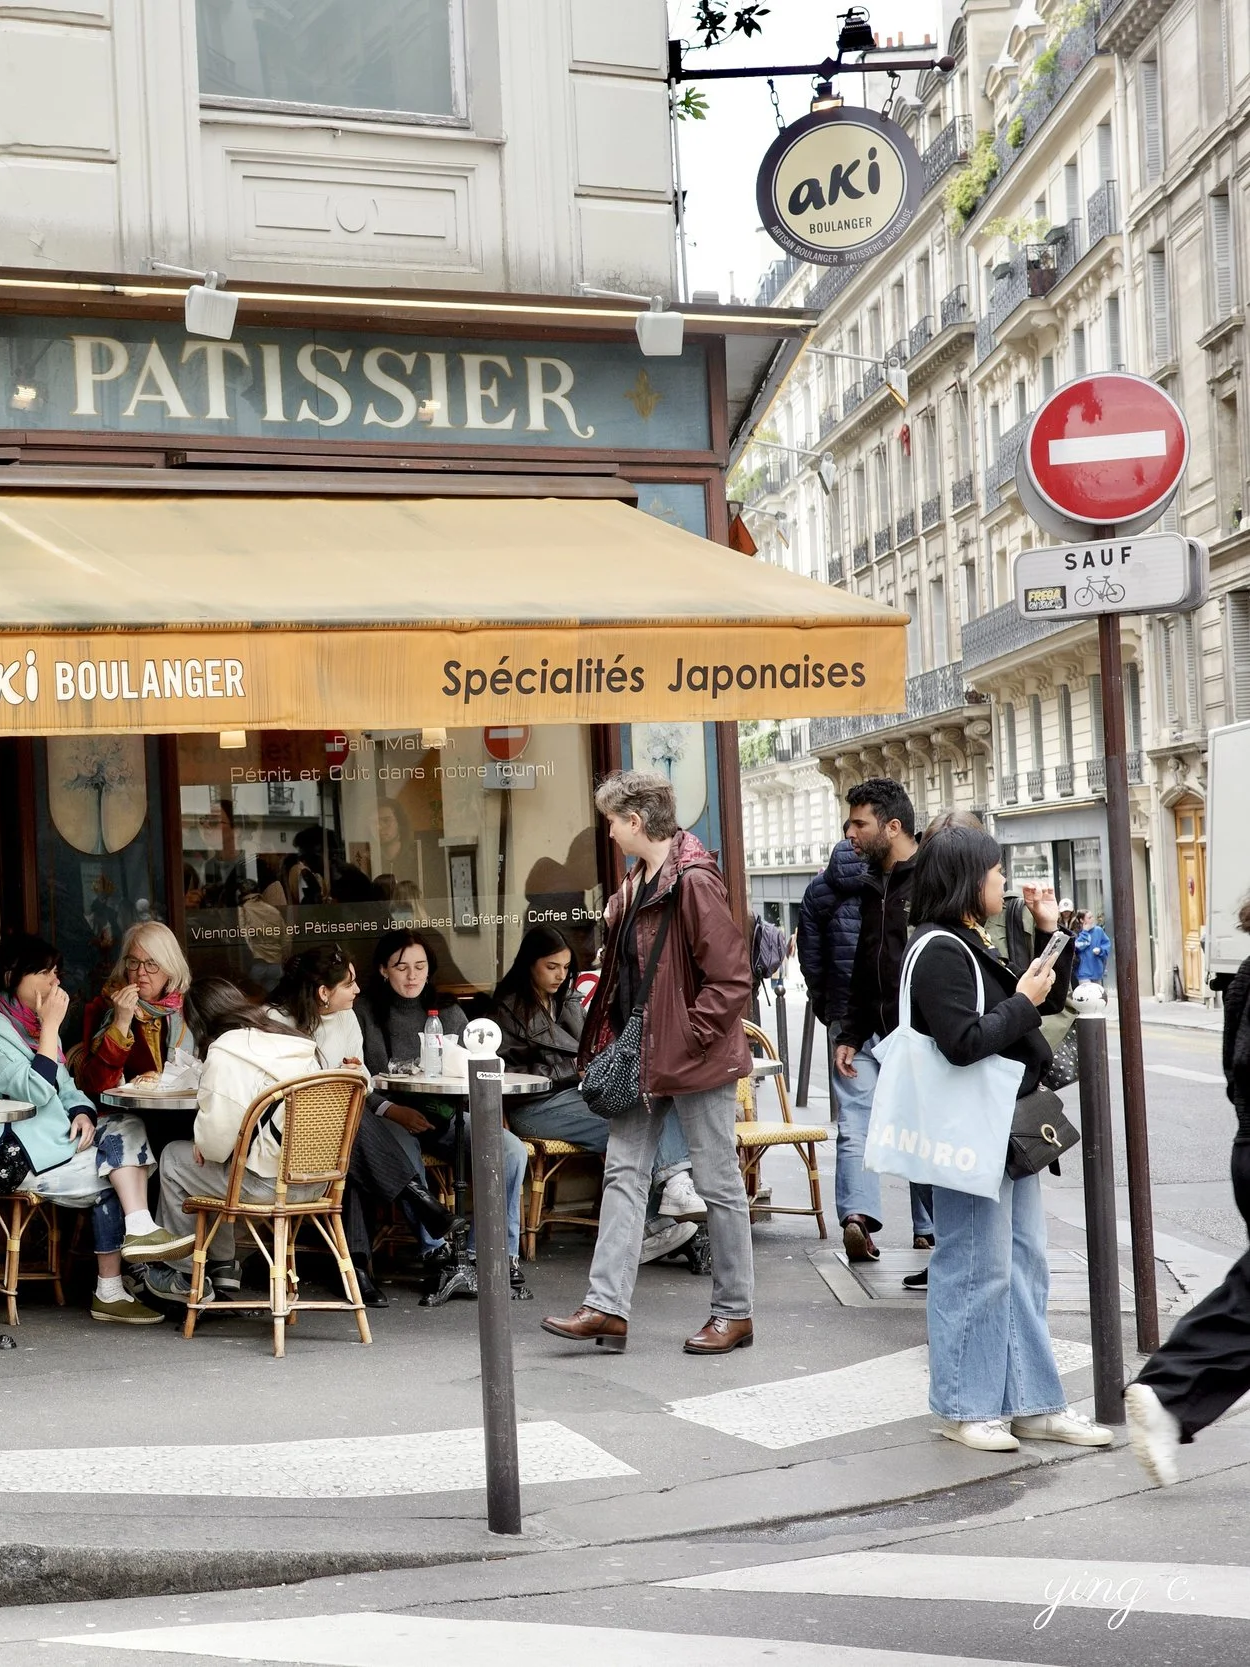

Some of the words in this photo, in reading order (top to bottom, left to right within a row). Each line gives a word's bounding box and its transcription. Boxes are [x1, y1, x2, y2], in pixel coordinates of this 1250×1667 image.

[771, 225, 795, 249] ARTISAN
[794, 247, 838, 263] BOULANGER
[845, 240, 886, 262] PATISSERIE
[885, 209, 913, 243] JAPONAISE
[809, 217, 872, 234] BOULANGER
[70, 335, 595, 439] PATISSIER
[1065, 546, 1132, 570] SAUF
[55, 659, 246, 702] BOULANGER
[442, 654, 645, 704] Spécialités
[668, 654, 866, 699] Japonaises
[334, 735, 376, 751] Pain
[385, 735, 456, 750] Maison
[230, 766, 291, 783] Pétrit
[300, 767, 321, 782] et
[329, 765, 370, 781] Cuit
[379, 764, 425, 780] dans
[434, 762, 488, 778] notre
[495, 761, 555, 778] fournil
[191, 924, 281, 940] Viennoiseries
[286, 923, 299, 935] et
[305, 918, 378, 933] Pâtisseries
[528, 910, 567, 923] Coffee
[572, 908, 602, 922] Shop
